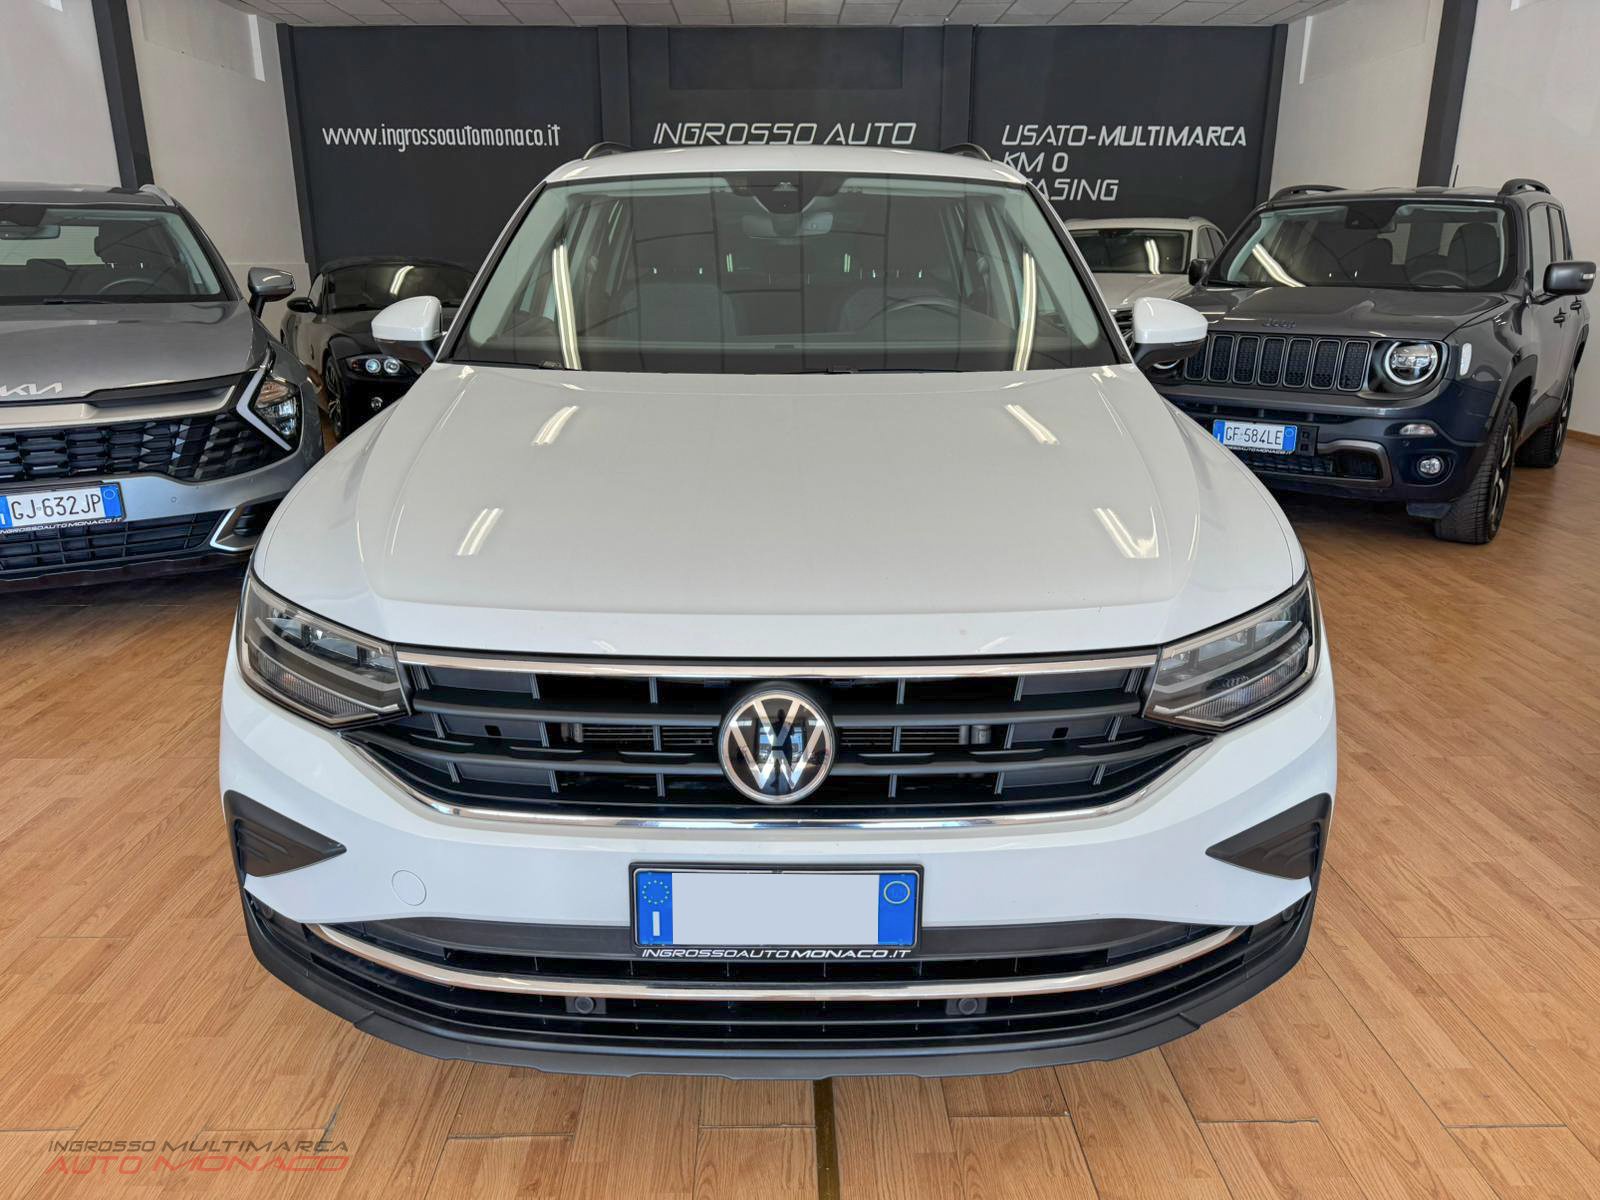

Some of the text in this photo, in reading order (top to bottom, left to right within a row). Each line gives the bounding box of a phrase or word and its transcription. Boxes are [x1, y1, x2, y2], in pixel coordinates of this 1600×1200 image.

[322, 124, 561, 152] www.ingrossoautomonaco.it
[653, 122, 917, 145] INGROSSO AUTO
[1001, 124, 1247, 147] USATO-MULTIMARCA
[1003, 151, 1045, 172] KM
[1027, 178, 1119, 201] ASING
